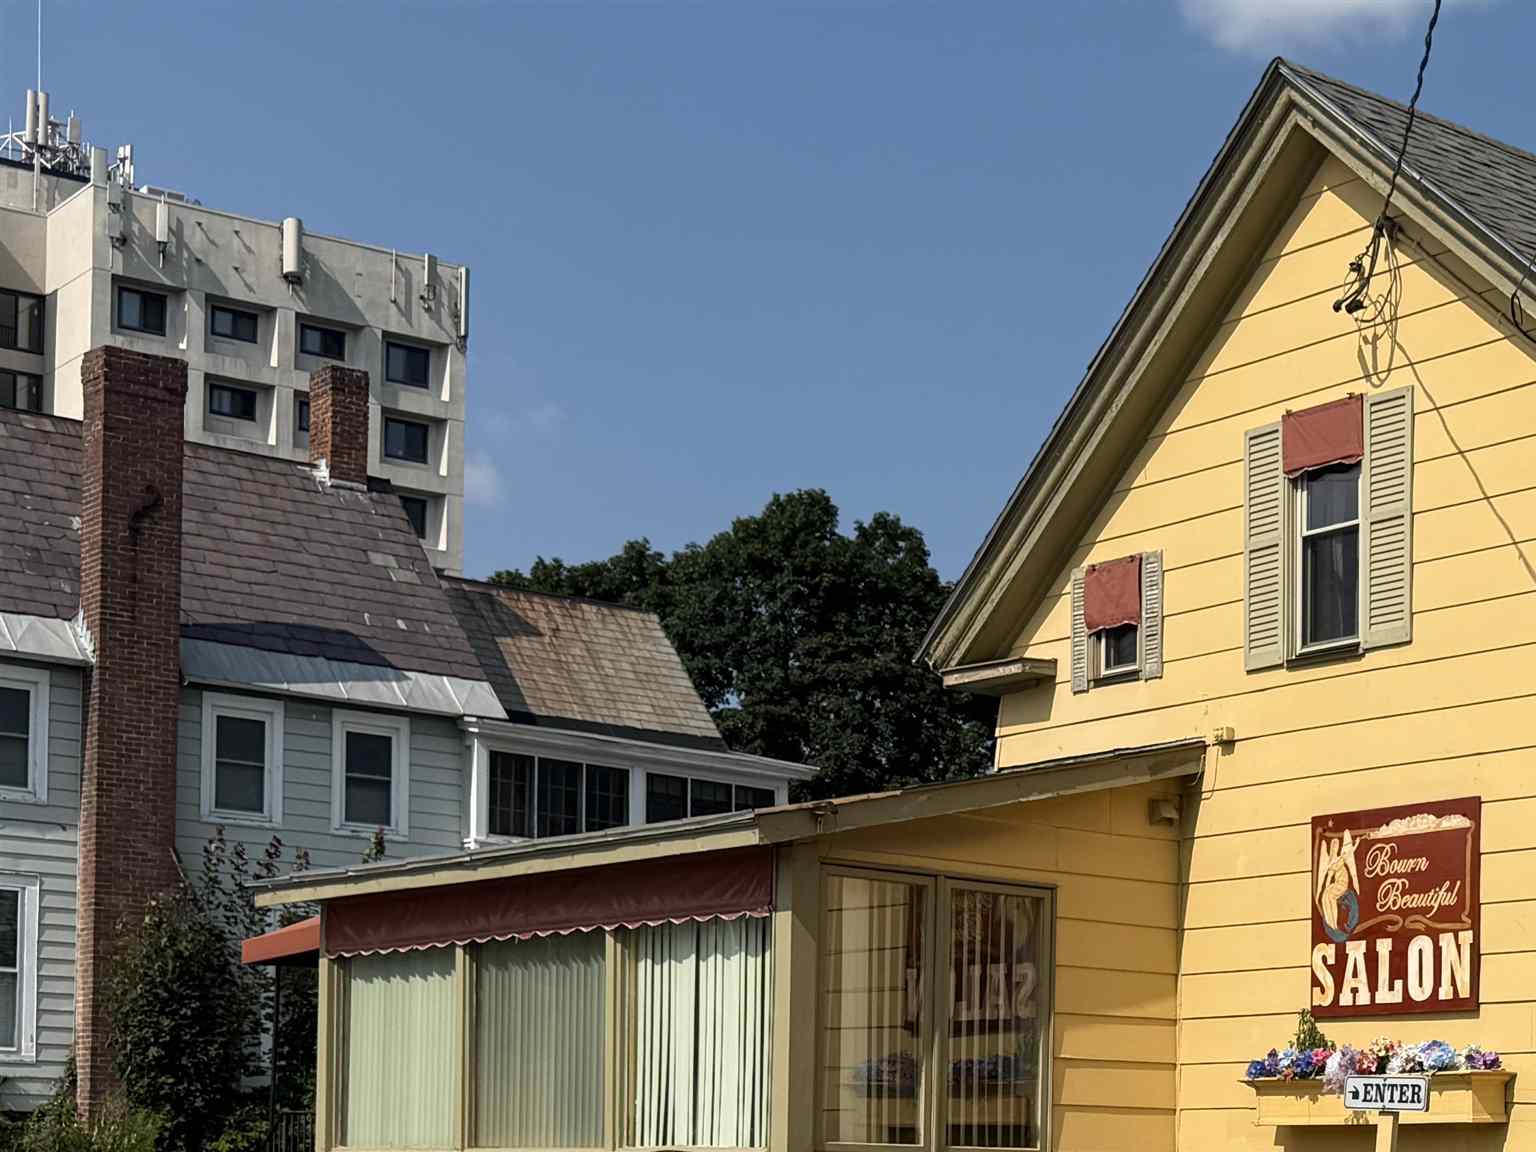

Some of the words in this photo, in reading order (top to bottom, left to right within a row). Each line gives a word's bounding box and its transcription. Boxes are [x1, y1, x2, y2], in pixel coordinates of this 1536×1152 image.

[1364, 842, 1430, 878] Bourn
[1375, 877, 1461, 918] Beautiful
[1311, 929, 1474, 1007] SALON
[1361, 1083, 1423, 1104] ENTER
